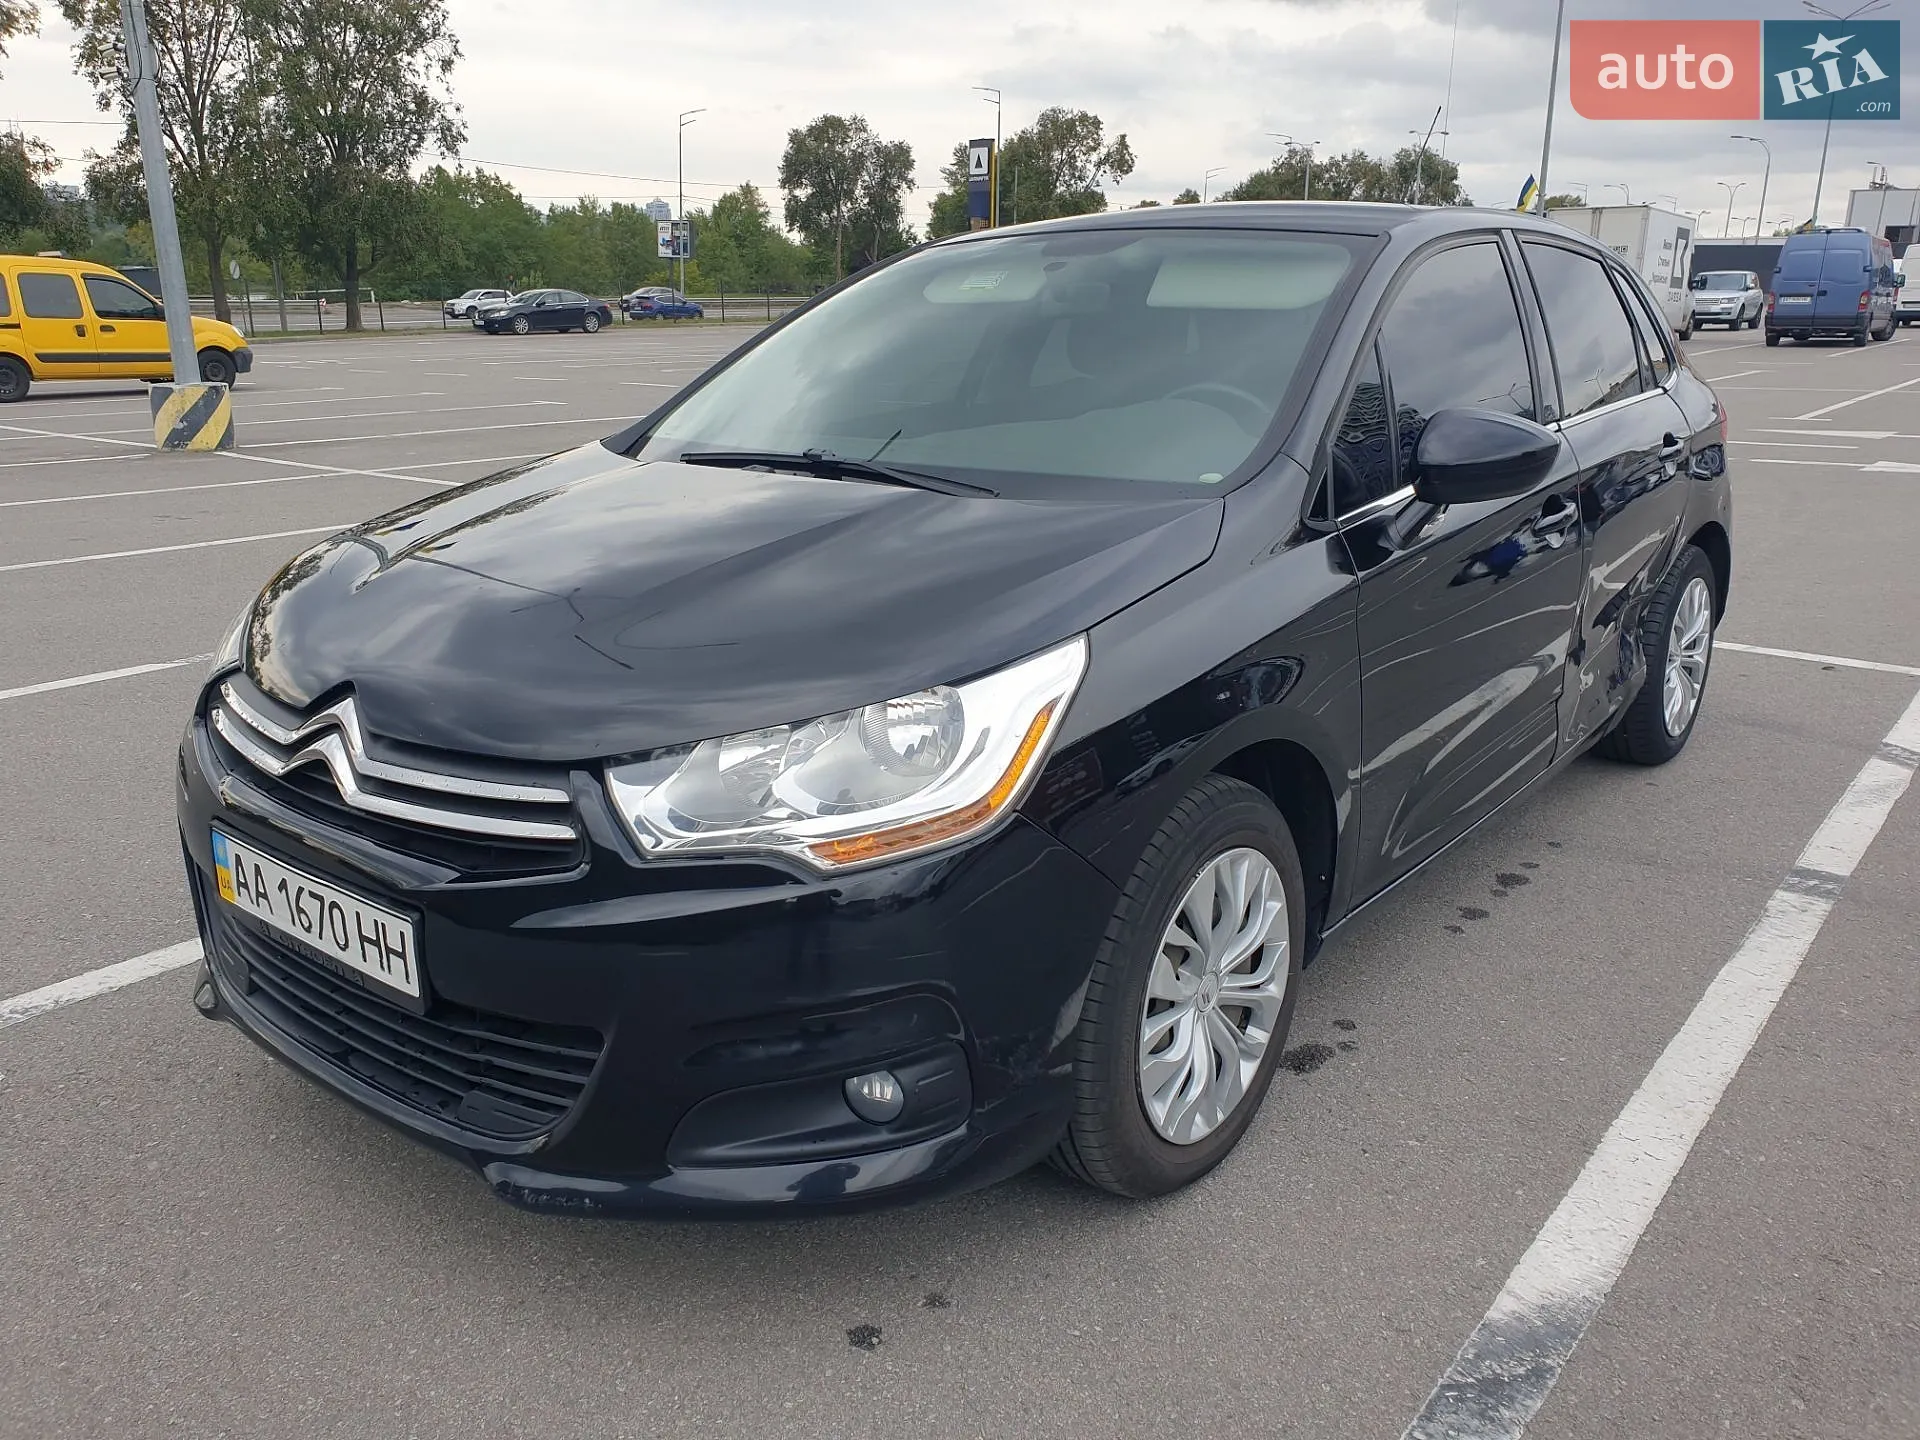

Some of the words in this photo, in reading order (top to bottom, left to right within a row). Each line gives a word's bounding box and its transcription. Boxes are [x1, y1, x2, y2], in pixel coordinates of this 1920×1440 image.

[220, 875, 233, 890] UA
[234, 853, 274, 915] AA
[277, 877, 349, 951] 1670
[355, 911, 410, 984] HH
